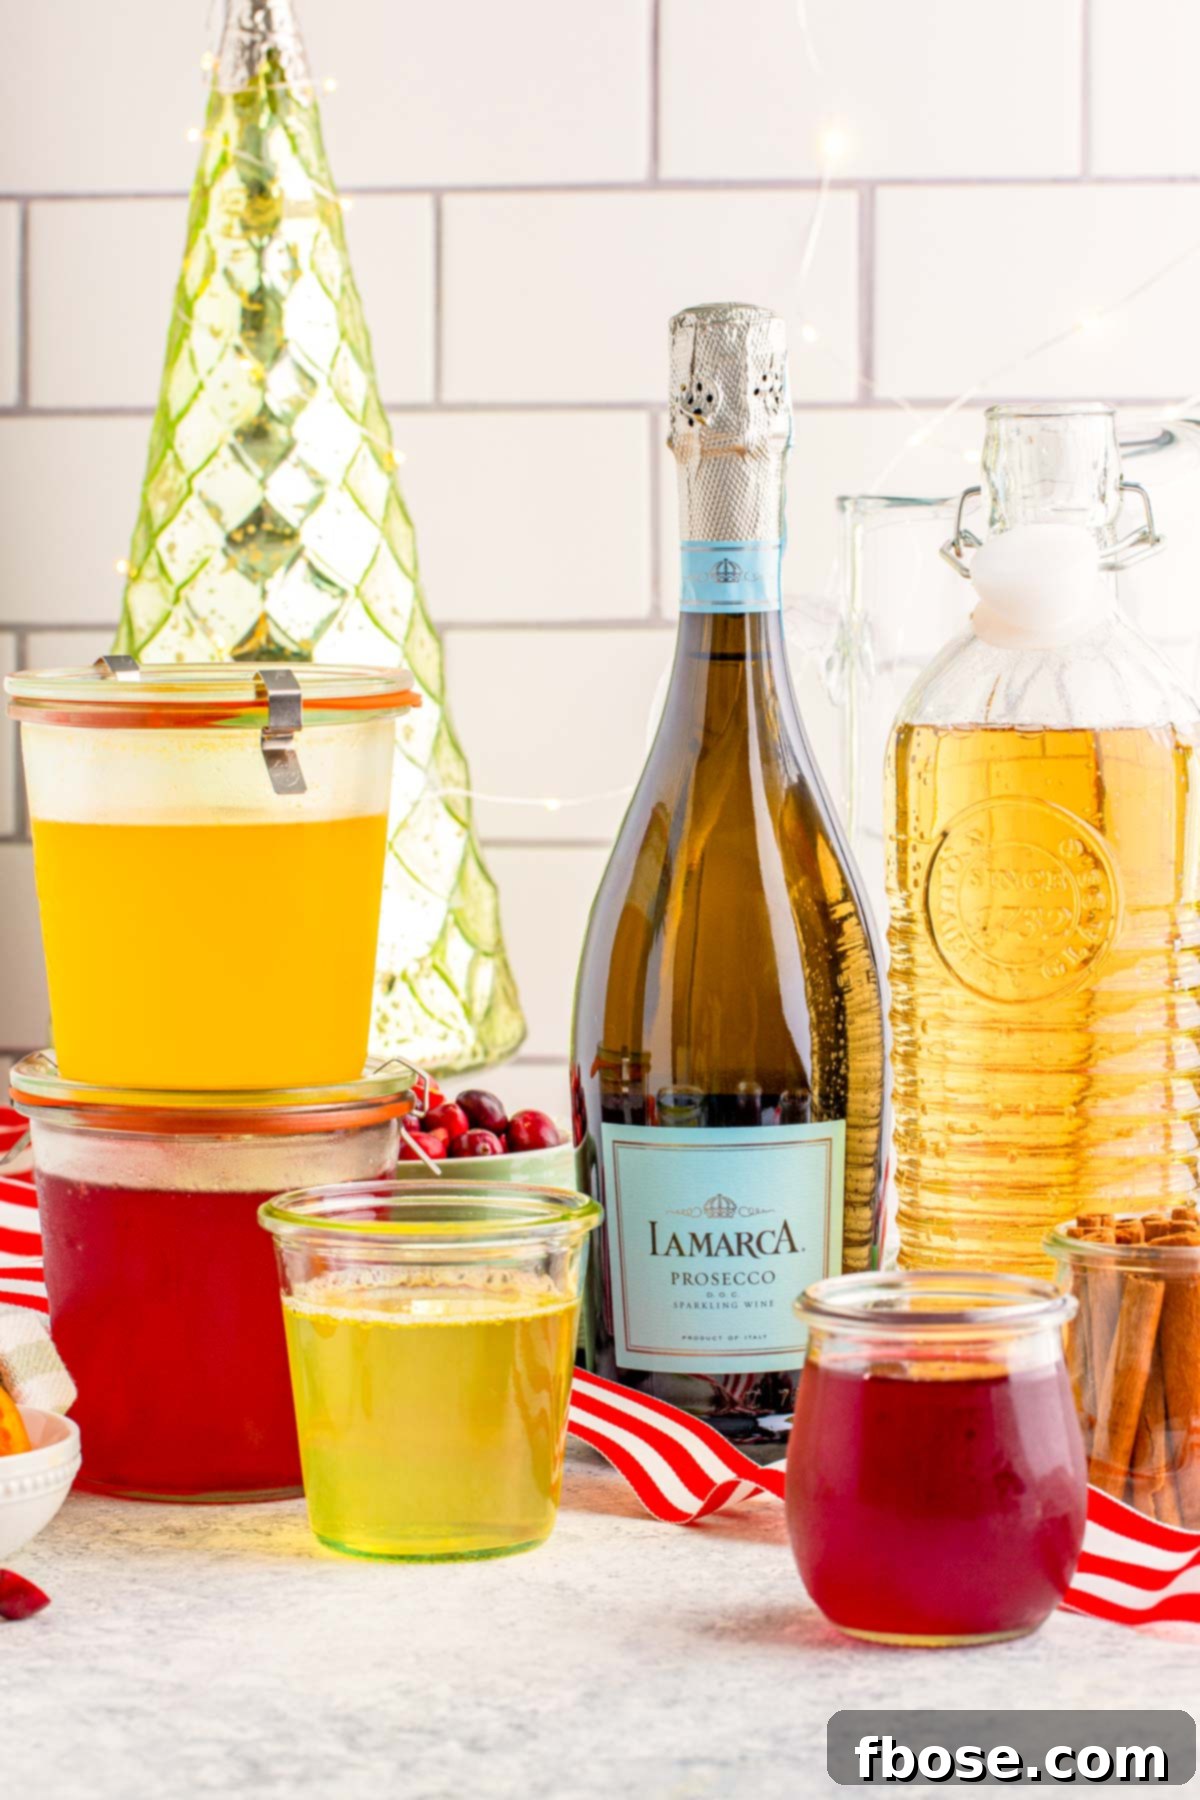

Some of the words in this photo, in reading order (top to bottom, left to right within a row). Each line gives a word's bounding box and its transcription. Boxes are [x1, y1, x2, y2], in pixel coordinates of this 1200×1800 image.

[671, 1271, 776, 1286] PROSECCO
[673, 1301, 739, 1310] SPARKLING
[743, 1300, 774, 1308] WINE
